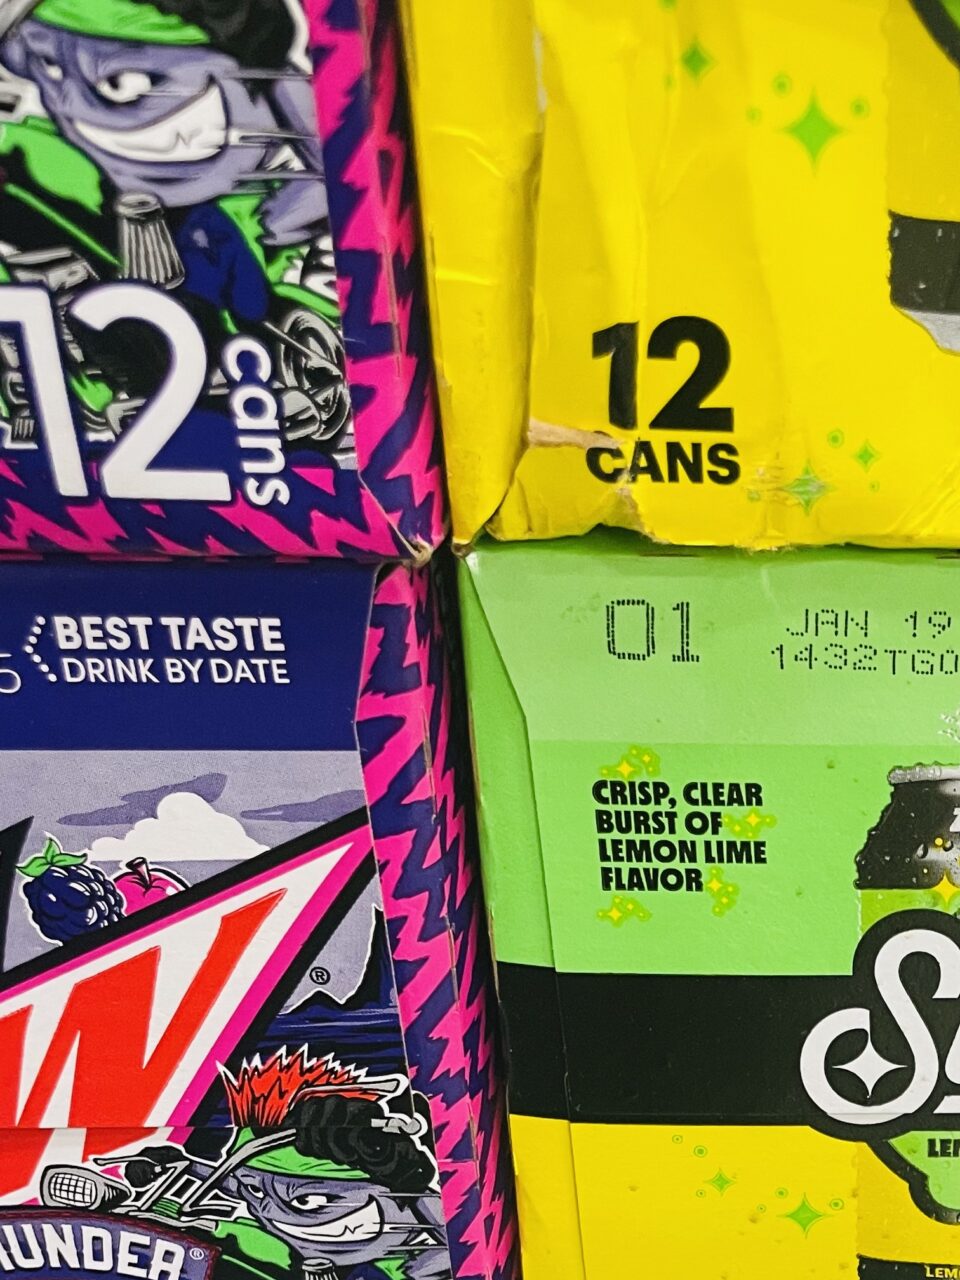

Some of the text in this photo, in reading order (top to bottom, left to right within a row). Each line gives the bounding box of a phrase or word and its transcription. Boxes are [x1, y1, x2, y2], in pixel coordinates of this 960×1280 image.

[592, 315, 734, 432] 12
[0, 284, 231, 501] 12
[224, 337, 290, 506] cans
[586, 432, 741, 485] CANS
[53, 616, 285, 651] BEST TASTE
[605, 599, 700, 662] 01
[785, 609, 868, 638] JAN
[904, 610, 952, 639] 19
[61, 657, 290, 684] DRINK BY DATE
[592, 779, 763, 809] CRISP, CLEAR
[595, 809, 723, 836] BURST OF
[598, 838, 768, 864] LEMON LIME
[601, 866, 704, 892] FLAVOR
